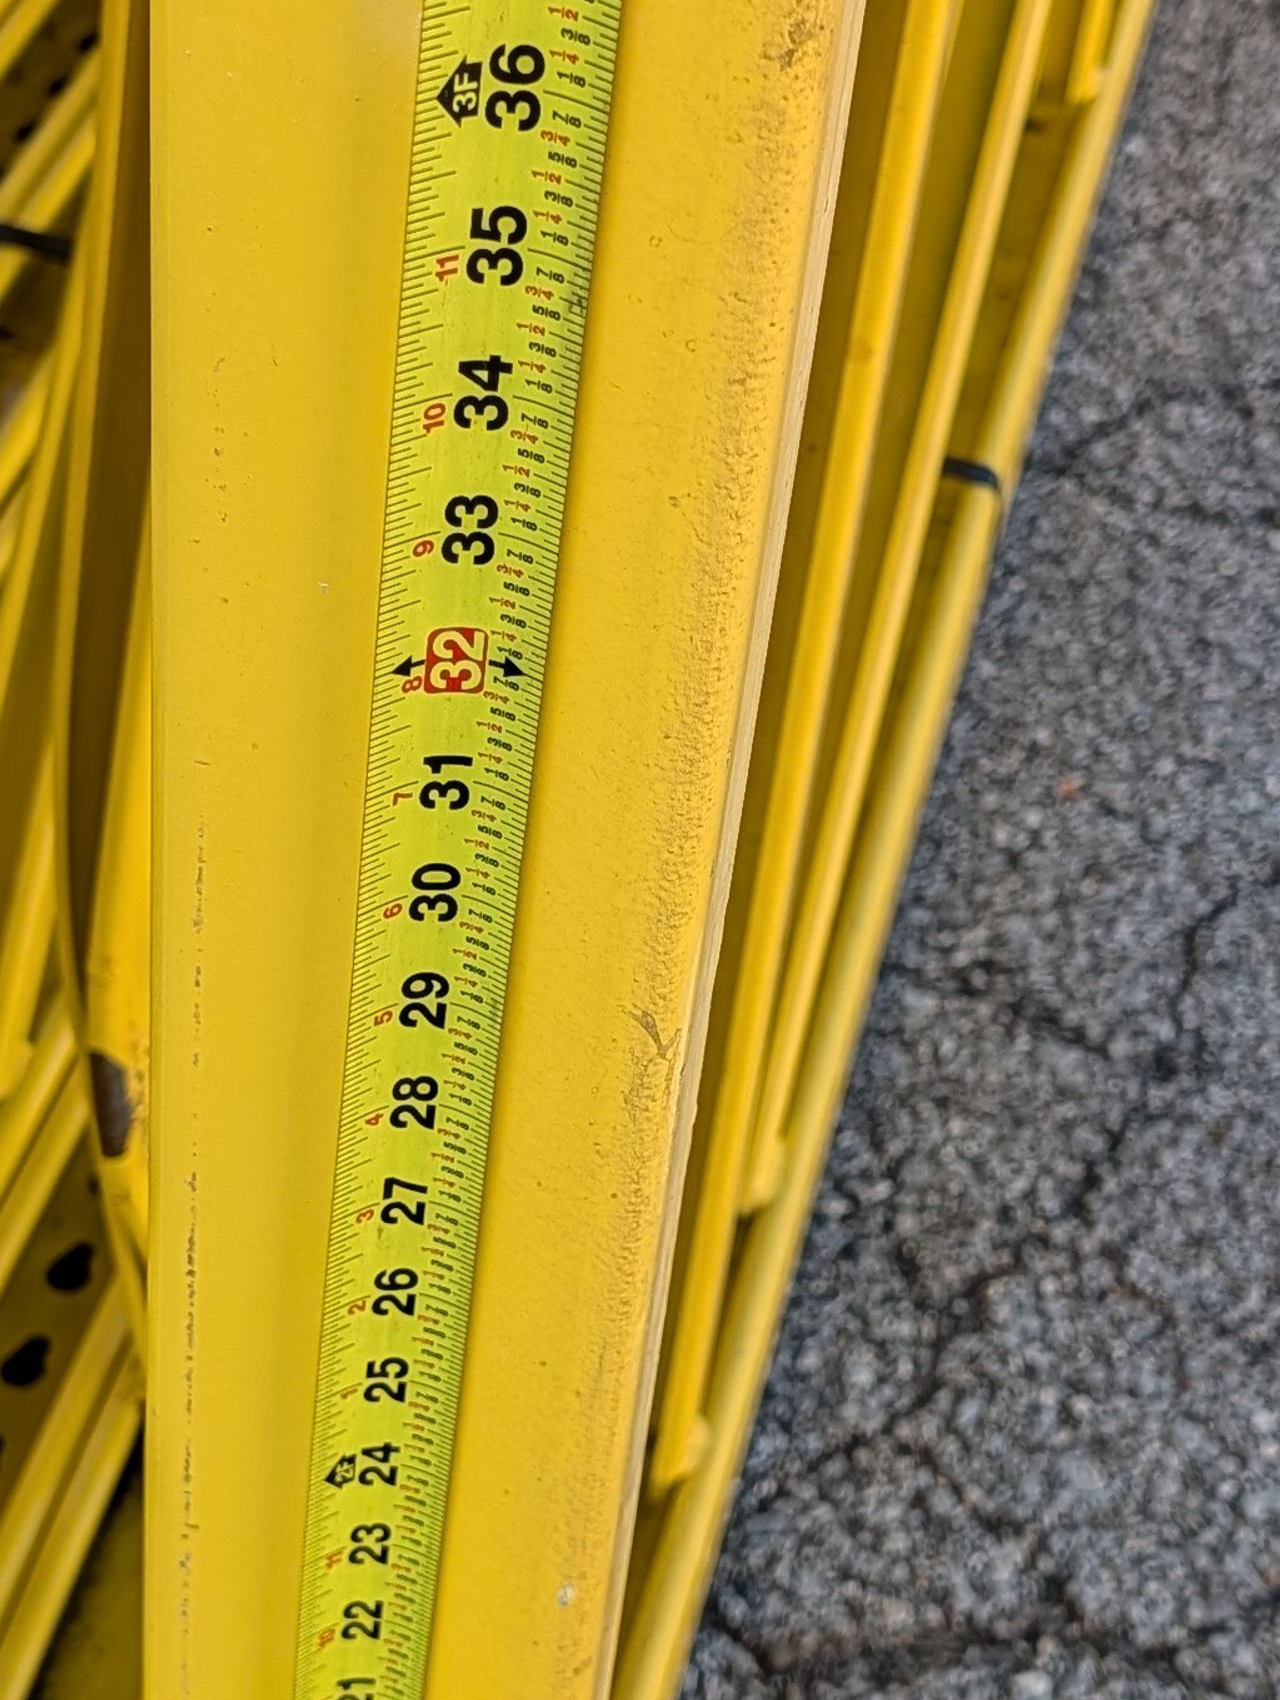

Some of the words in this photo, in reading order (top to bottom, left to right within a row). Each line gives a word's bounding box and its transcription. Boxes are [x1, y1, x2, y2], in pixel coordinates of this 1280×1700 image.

[452, 72, 479, 113] 3F
[484, 44, 546, 132] 36
[466, 205, 528, 287] 35
[422, 402, 447, 435] 10
[453, 355, 513, 431] 34
[441, 495, 499, 566] 33
[430, 630, 485, 690] 32
[419, 755, 473, 810] 31
[408, 863, 461, 922] 30
[398, 971, 450, 1029] 29
[389, 1075, 439, 1130] 28
[380, 1177, 428, 1226] 27
[371, 1268, 419, 1316] 26
[363, 1356, 409, 1403] 25
[358, 1442, 401, 1486] 24
[348, 1522, 392, 1565] 23
[340, 1600, 384, 1640] 22
